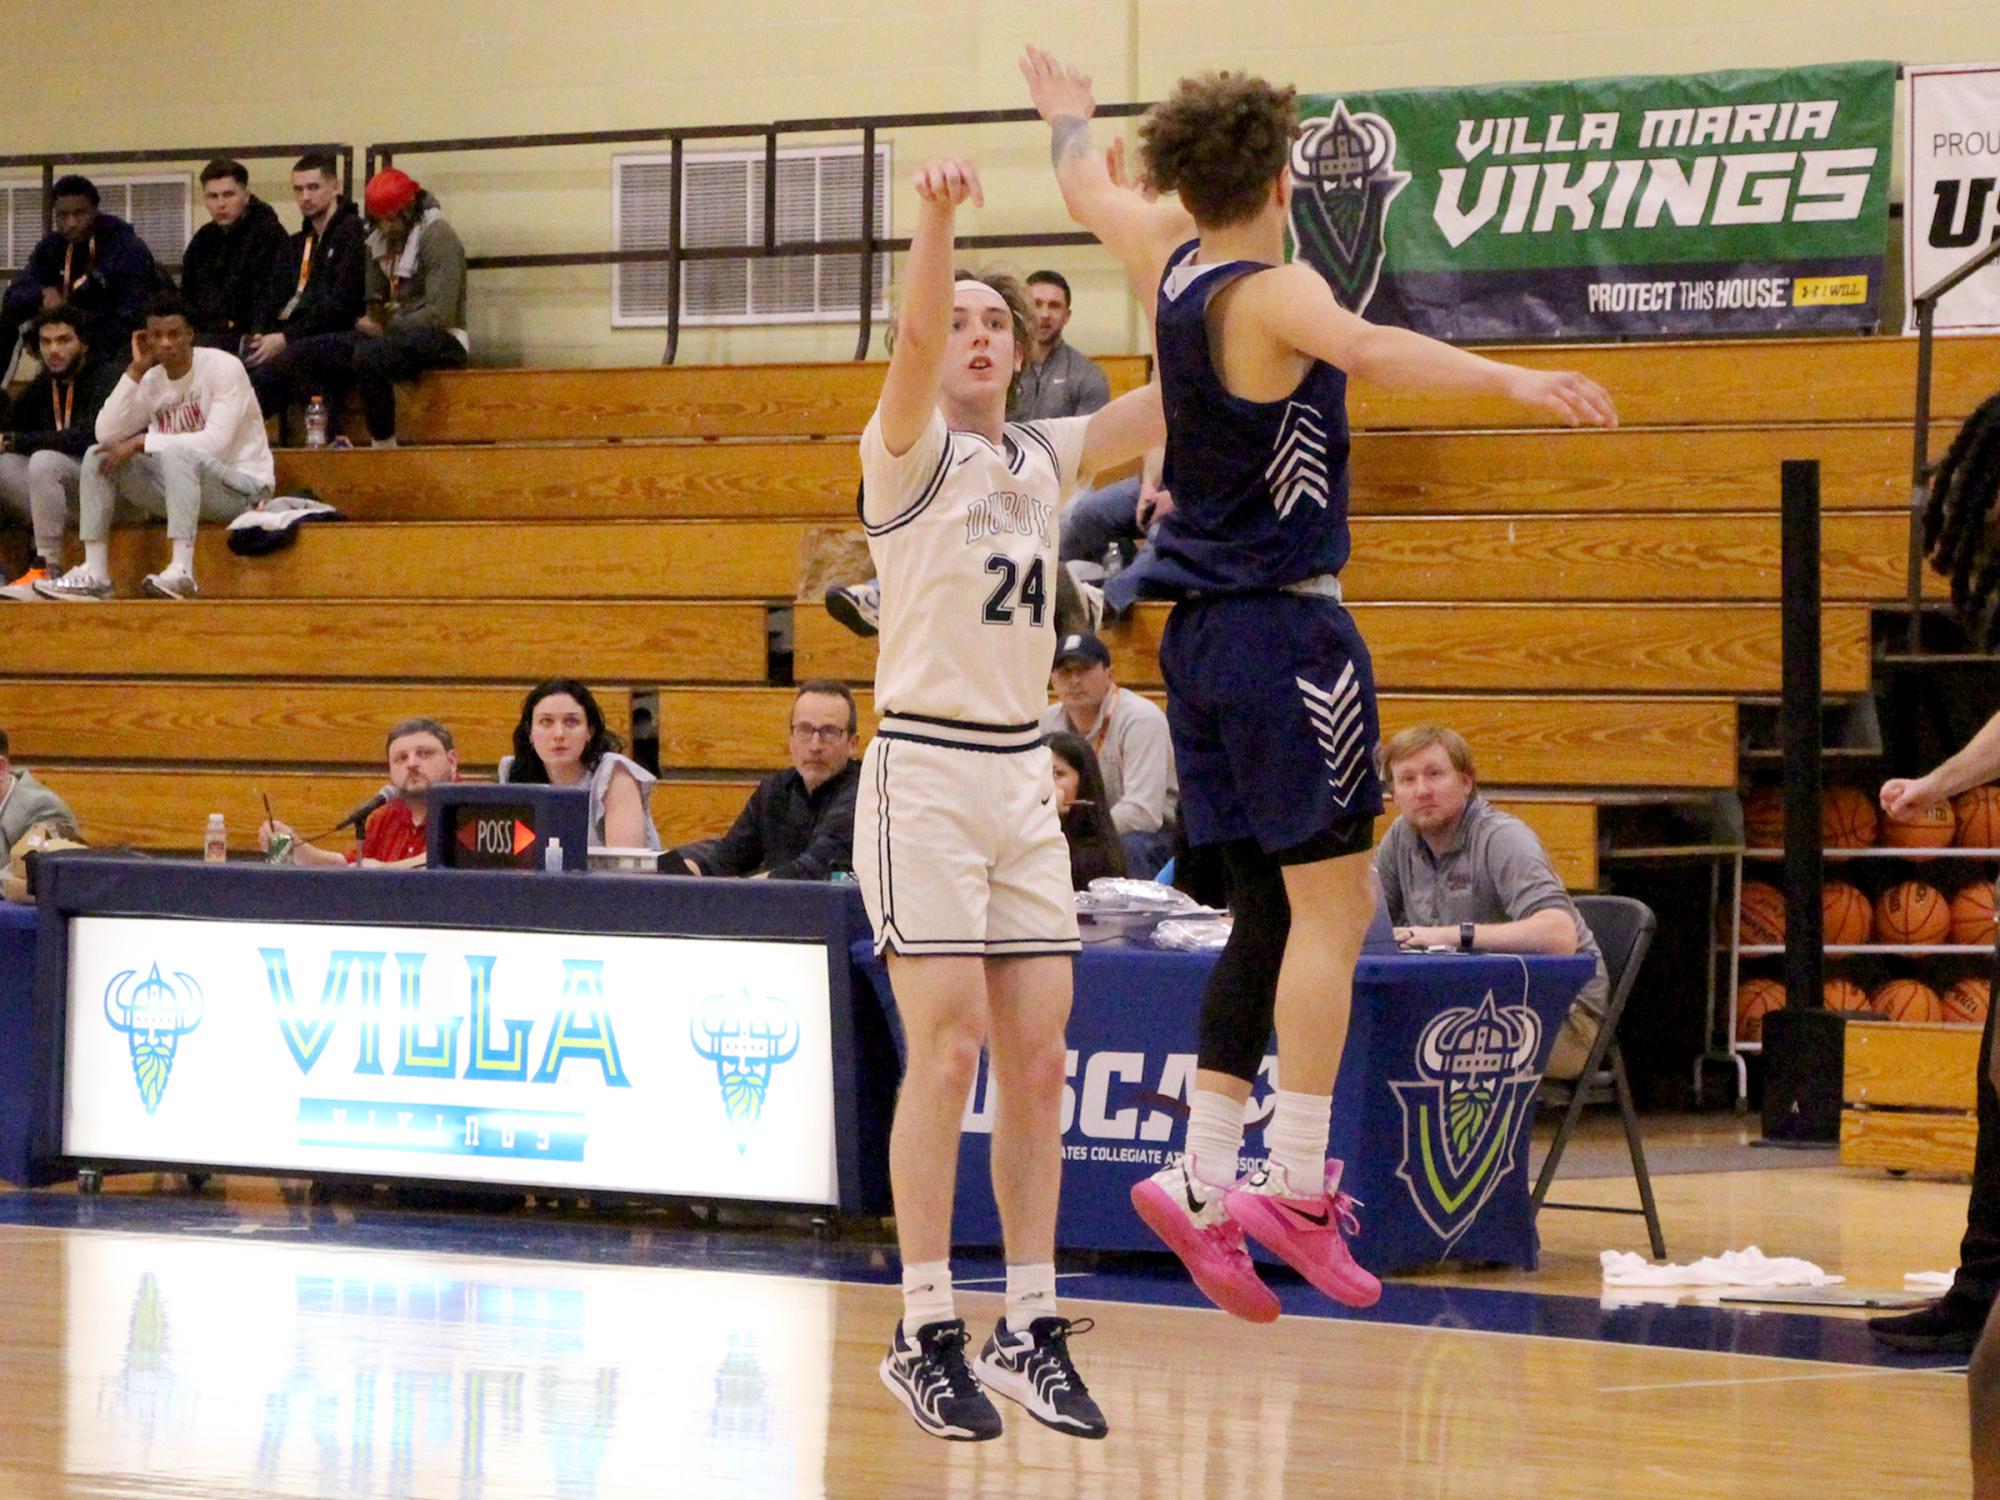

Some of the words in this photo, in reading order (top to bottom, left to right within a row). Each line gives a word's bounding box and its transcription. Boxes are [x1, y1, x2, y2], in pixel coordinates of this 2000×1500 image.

[1455, 112, 1620, 163] VILLA
[1639, 99, 1839, 150] MARIA
[1933, 131, 2000, 158] PROU
[1432, 147, 1878, 249] VIKINGS
[1588, 282, 1676, 313] PROTECT
[1680, 281, 1715, 310] THIS
[1716, 278, 1787, 309] HOUSE
[982, 553, 1047, 628] 24
[477, 819, 513, 854] POSS
[257, 947, 632, 1088] VILLA
[1091, 1147, 1162, 1165] COLLEGIATE
